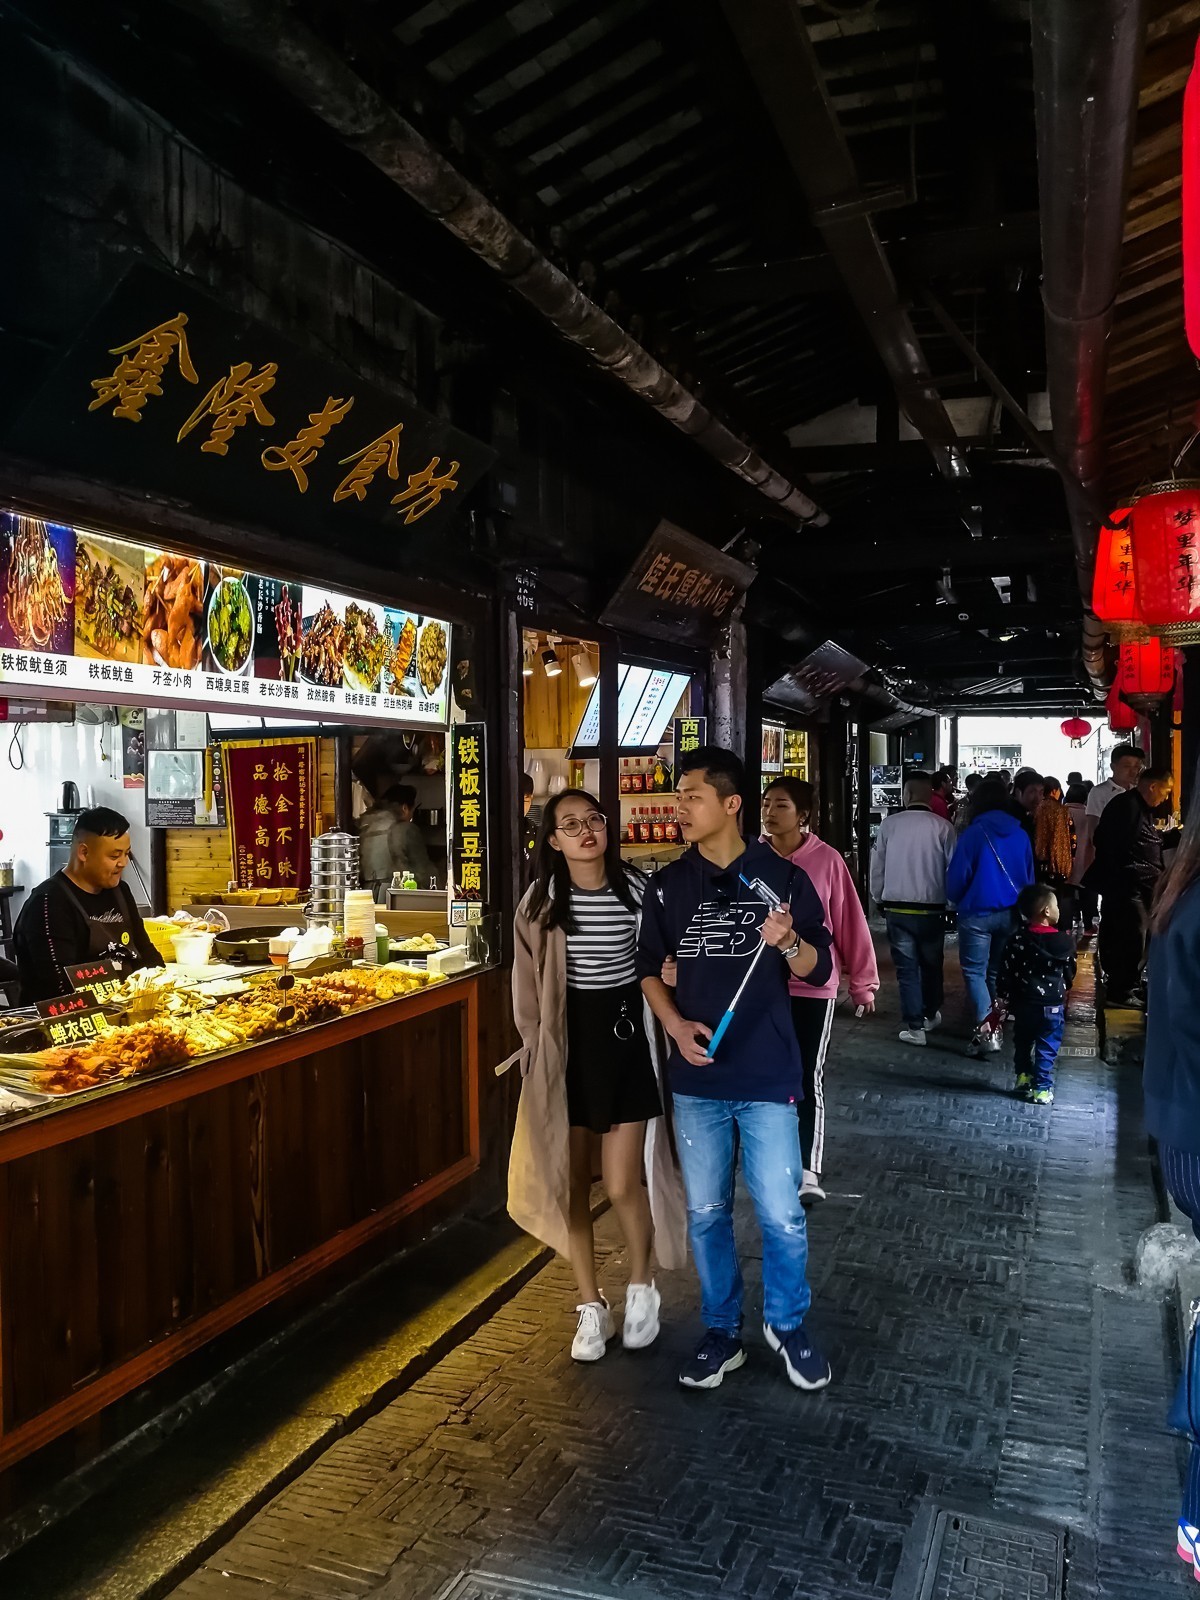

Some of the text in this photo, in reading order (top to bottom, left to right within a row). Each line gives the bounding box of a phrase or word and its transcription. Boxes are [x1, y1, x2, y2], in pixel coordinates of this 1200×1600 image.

[1172, 508, 1200, 594] 梦里年华
[1, 653, 68, 676] 铁板鱿鱼须
[88, 662, 134, 683] 铁板鱿鱼
[152, 670, 192, 688] 牙签小肉
[206, 676, 250, 694] 西塘臭豆腐
[259, 682, 299, 700] 老长沙香肠
[307, 688, 336, 703] 孜然脆骨
[345, 692, 377, 707] 铁板香豆腐
[252, 763, 273, 880] 品德高尚
[273, 761, 297, 878] 拾金不昧
[458, 736, 482, 890] 铁板香豆腐
[75, 966, 108, 979] 特色小吃
[48, 999, 88, 1015] 特色小吃
